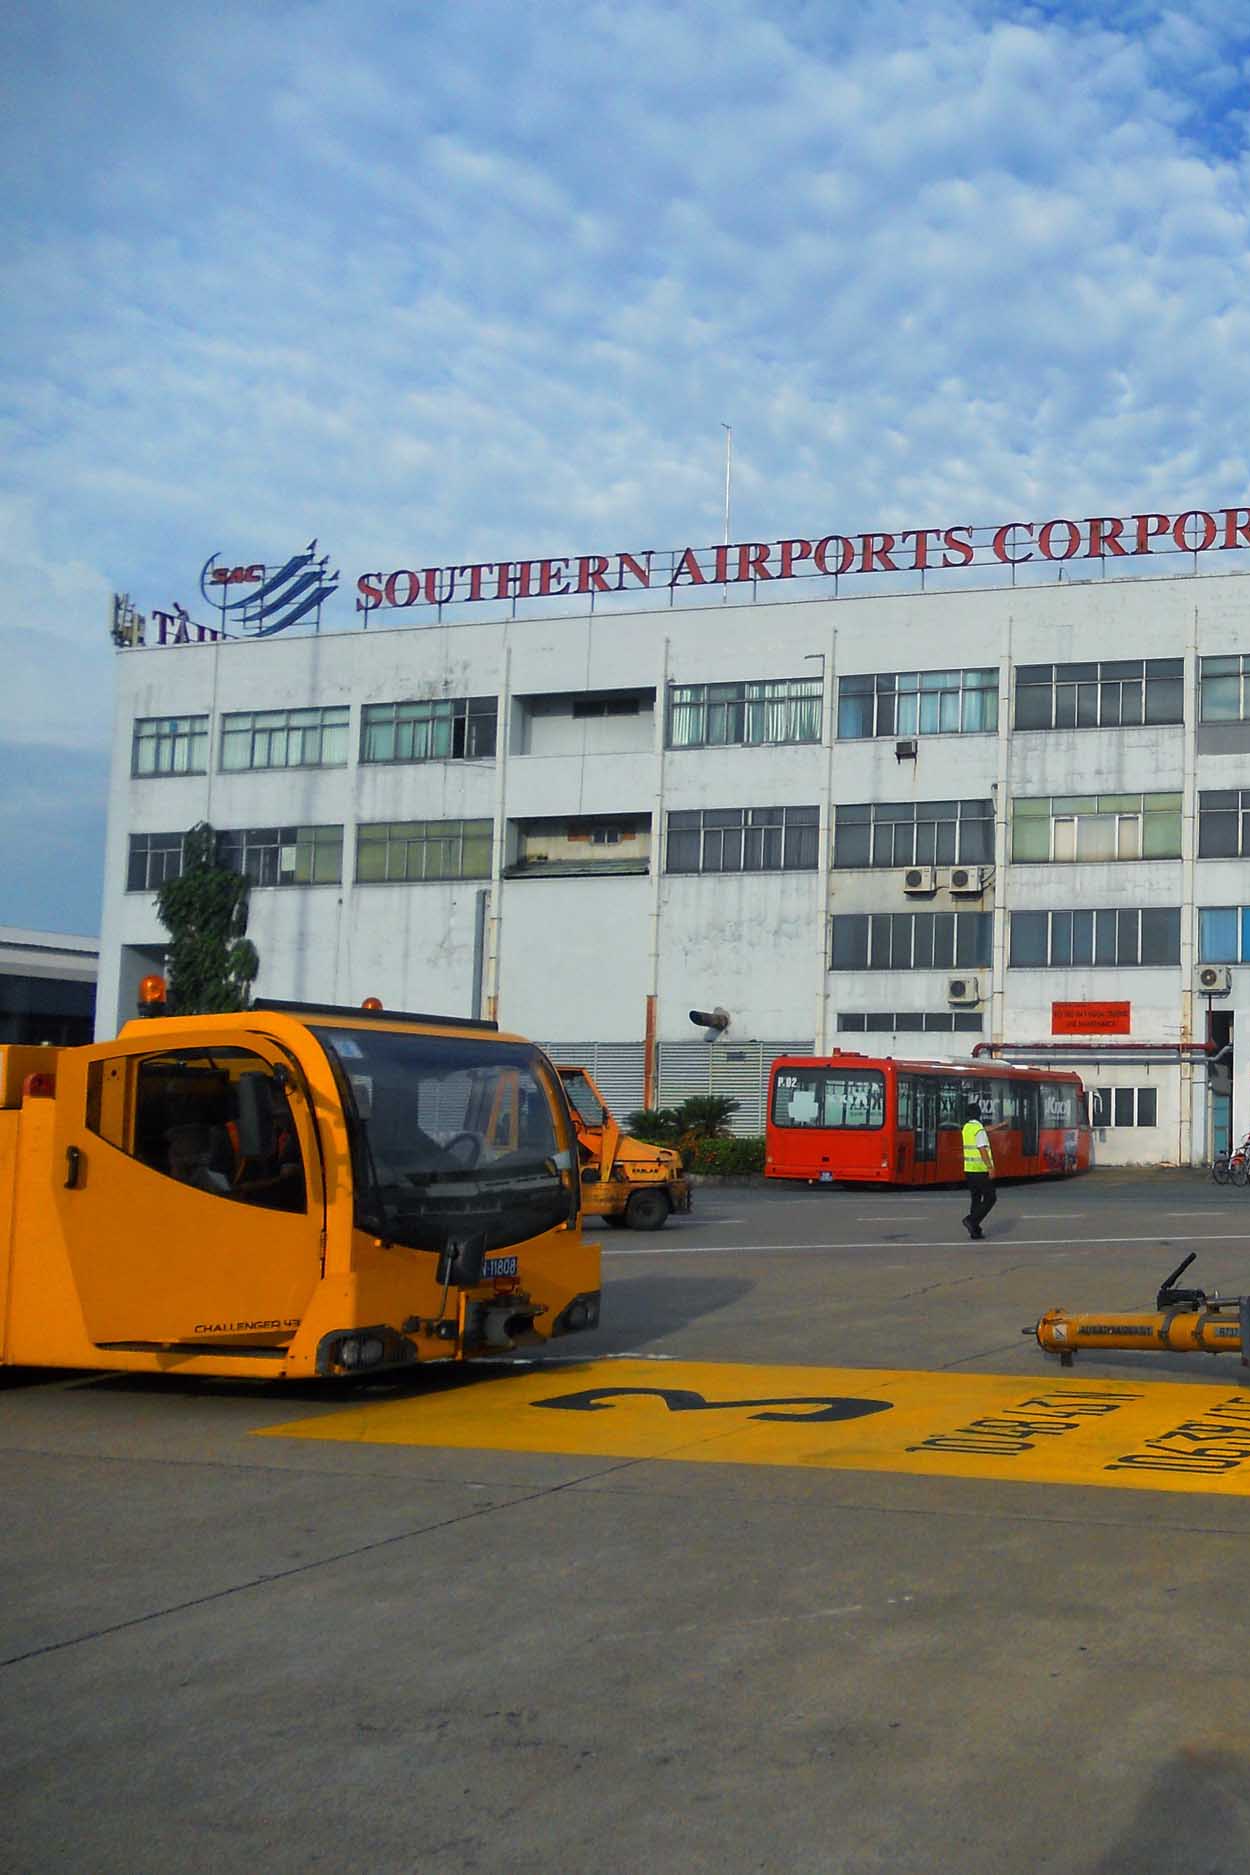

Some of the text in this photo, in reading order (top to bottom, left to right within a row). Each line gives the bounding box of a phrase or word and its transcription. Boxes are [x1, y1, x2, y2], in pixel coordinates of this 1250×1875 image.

[210, 564, 265, 585] SAC
[355, 550, 656, 612] SOUTHERN
[672, 526, 974, 587] AIRPORTS
[777, 1076, 798, 1088] P.02
[194, 1320, 280, 1334] CHALLENGER
